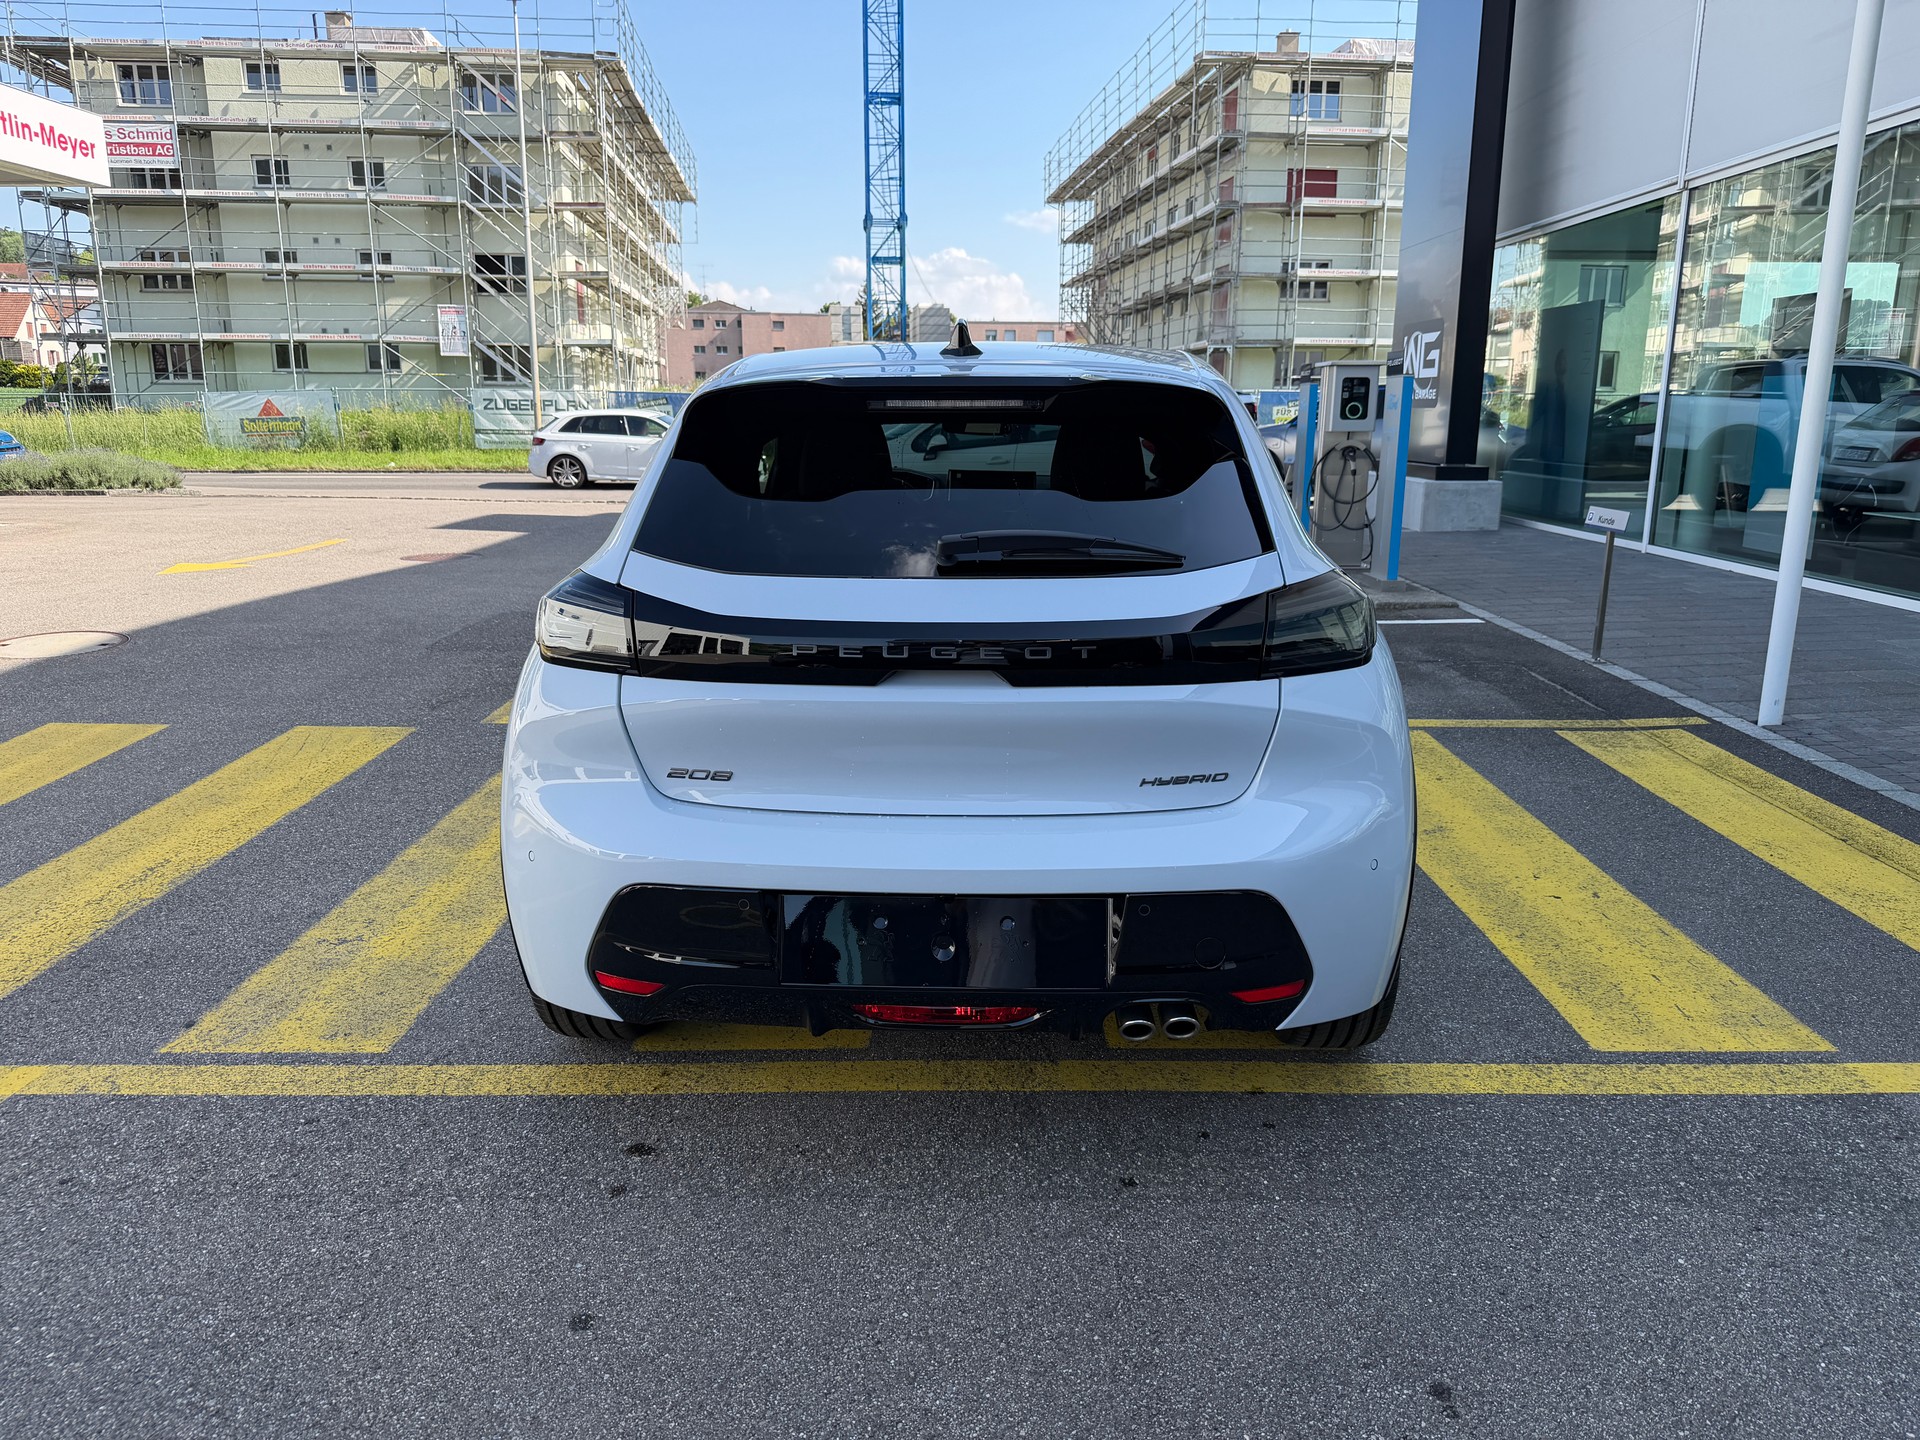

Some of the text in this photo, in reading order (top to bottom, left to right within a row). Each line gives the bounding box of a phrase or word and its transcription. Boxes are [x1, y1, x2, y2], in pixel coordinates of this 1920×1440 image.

[116, 127, 174, 142] Schmid
[155, 144, 174, 156] AG
[1414, 389, 1437, 400] GARAGE
[482, 398, 590, 412] ZUGEPLAN
[1275, 406, 1292, 417] FÜR
[1597, 515, 1616, 526] Kunde
[791, 643, 1098, 659] PEUGEOT
[666, 767, 734, 782] 208
[1138, 771, 1230, 788] HYBRID
